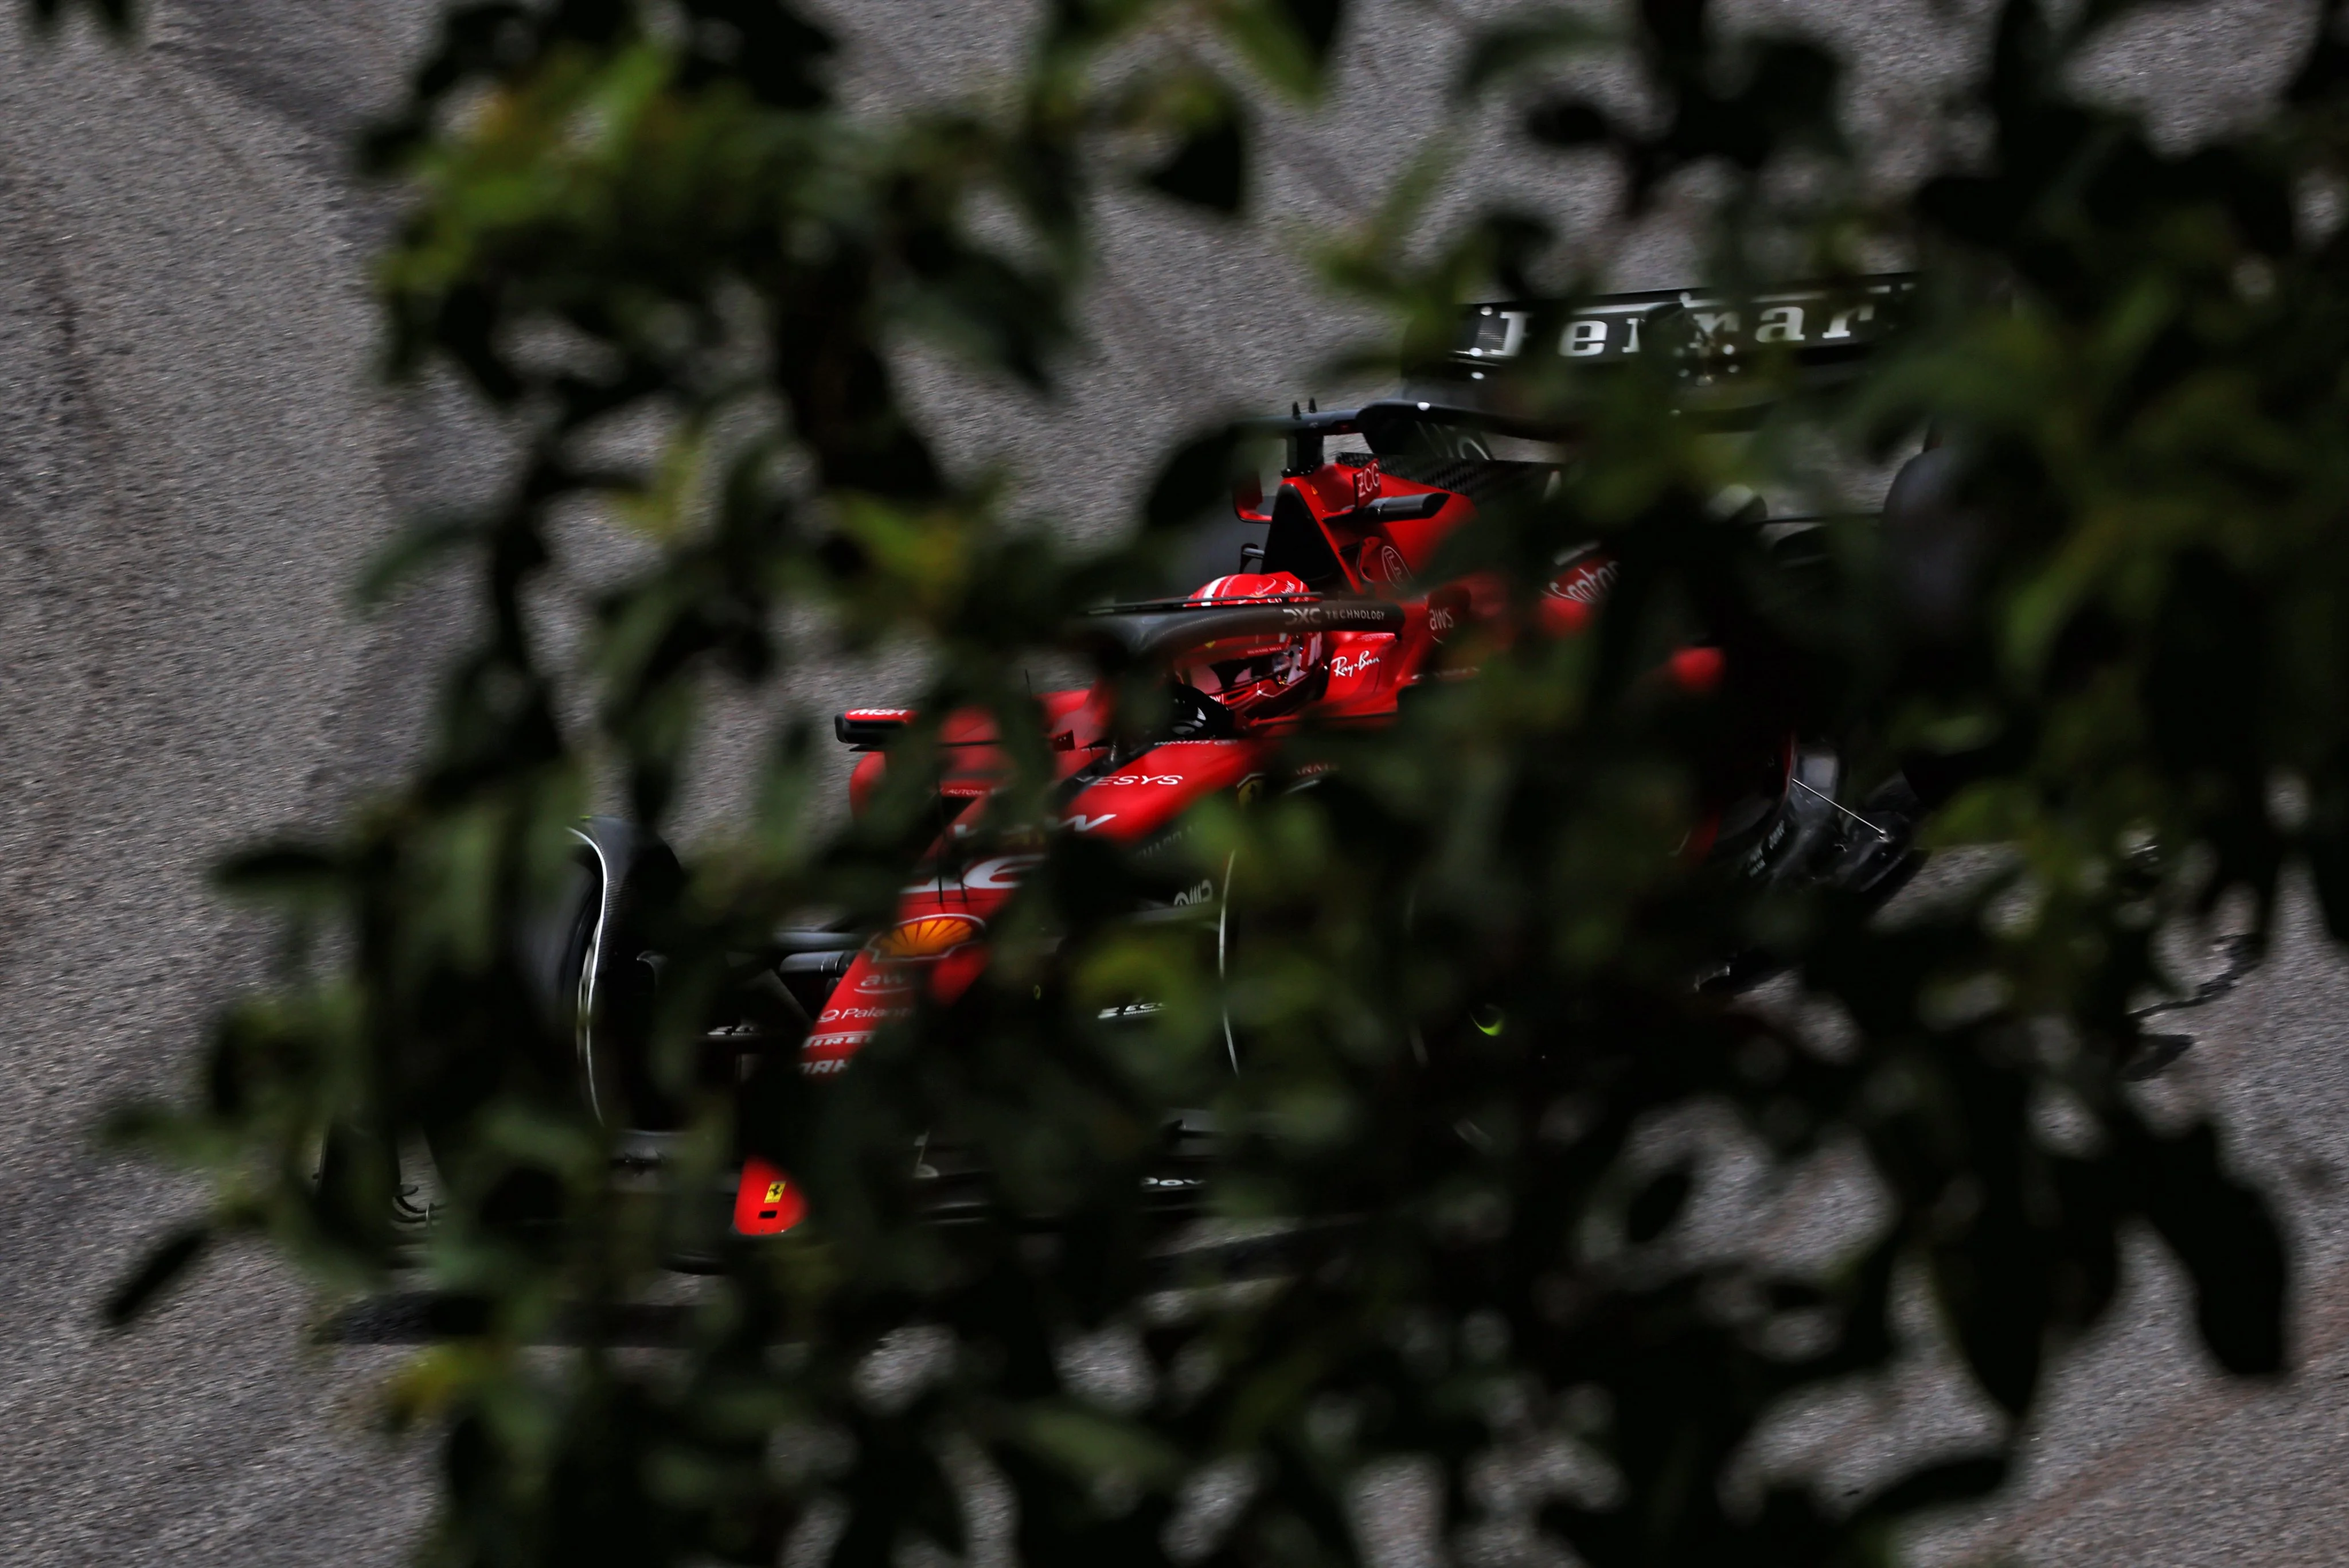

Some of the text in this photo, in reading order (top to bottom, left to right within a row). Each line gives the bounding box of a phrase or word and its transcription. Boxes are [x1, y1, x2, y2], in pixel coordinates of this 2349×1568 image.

[1356, 462, 1380, 498] ZCG
[1282, 607, 1386, 626] DXC TECHNOLOGY
[1429, 607, 1454, 631] aws
